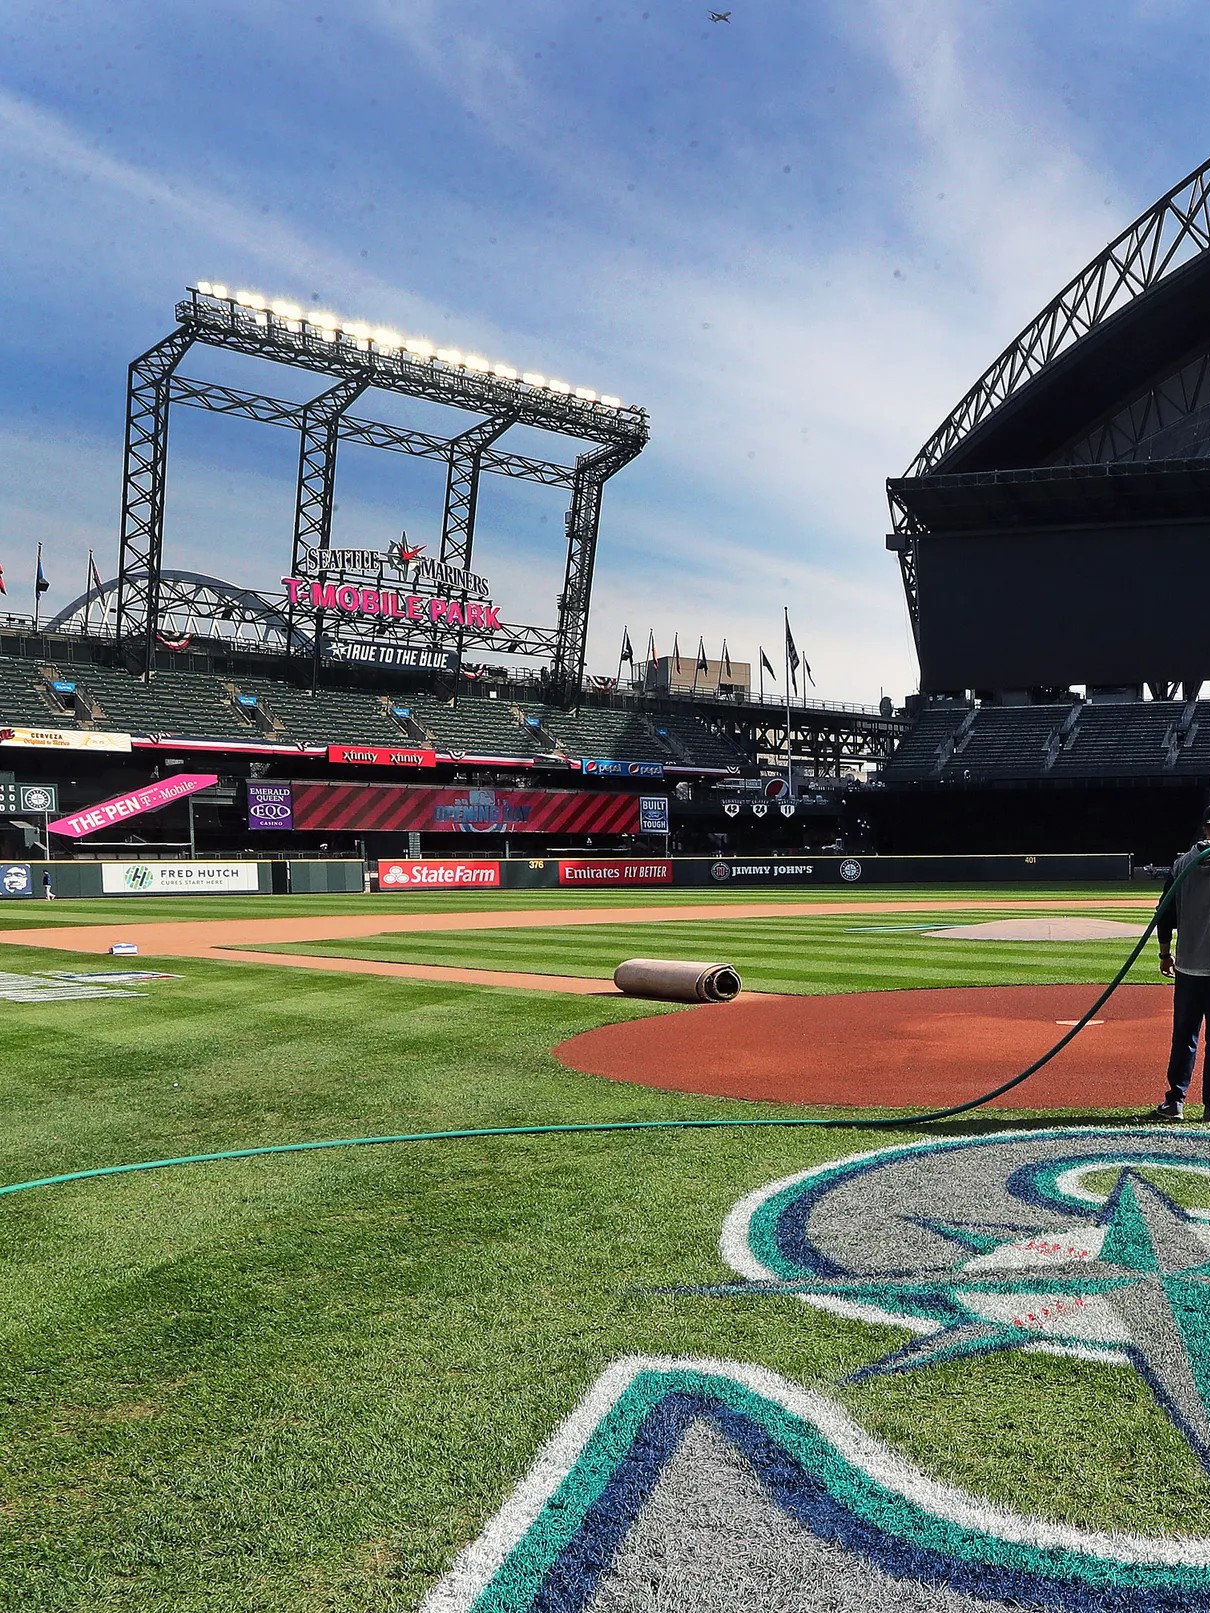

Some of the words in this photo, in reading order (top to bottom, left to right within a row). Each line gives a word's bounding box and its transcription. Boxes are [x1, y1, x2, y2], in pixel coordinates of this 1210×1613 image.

[307, 549, 380, 572] SEATTLE
[419, 558, 490, 596] MARINERS
[281, 576, 425, 622] T-MOBILE
[428, 598, 502, 631] PARK
[378, 646, 395, 664] TO
[396, 649, 418, 666] THE
[418, 651, 449, 668] BLUE
[30, 732, 63, 740] CERVEZA
[343, 750, 379, 763] xfinity
[390, 753, 424, 766] xfinity
[598, 763, 622, 773] pepsi
[640, 765, 663, 776] pepsi
[250, 788, 290, 796] EMERALD
[642, 800, 666, 810] BUILT
[726, 805, 738, 814] 42
[755, 805, 765, 814] 24
[783, 805, 792, 814] 11
[433, 805, 500, 822] OPENING
[67, 810, 106, 834] THE
[642, 820, 666, 829] TOUGH
[528, 861, 544, 869] 376
[1024, 856, 1037, 864] 401
[160, 869, 193, 878] FRED
[198, 869, 239, 878] HUTCH
[564, 866, 620, 880] Emirates
[624, 866, 639, 879] FLY
[639, 865, 667, 878] BETTER
[732, 866, 771, 877] JIMMY
[773, 865, 813, 876] JOHN'S
